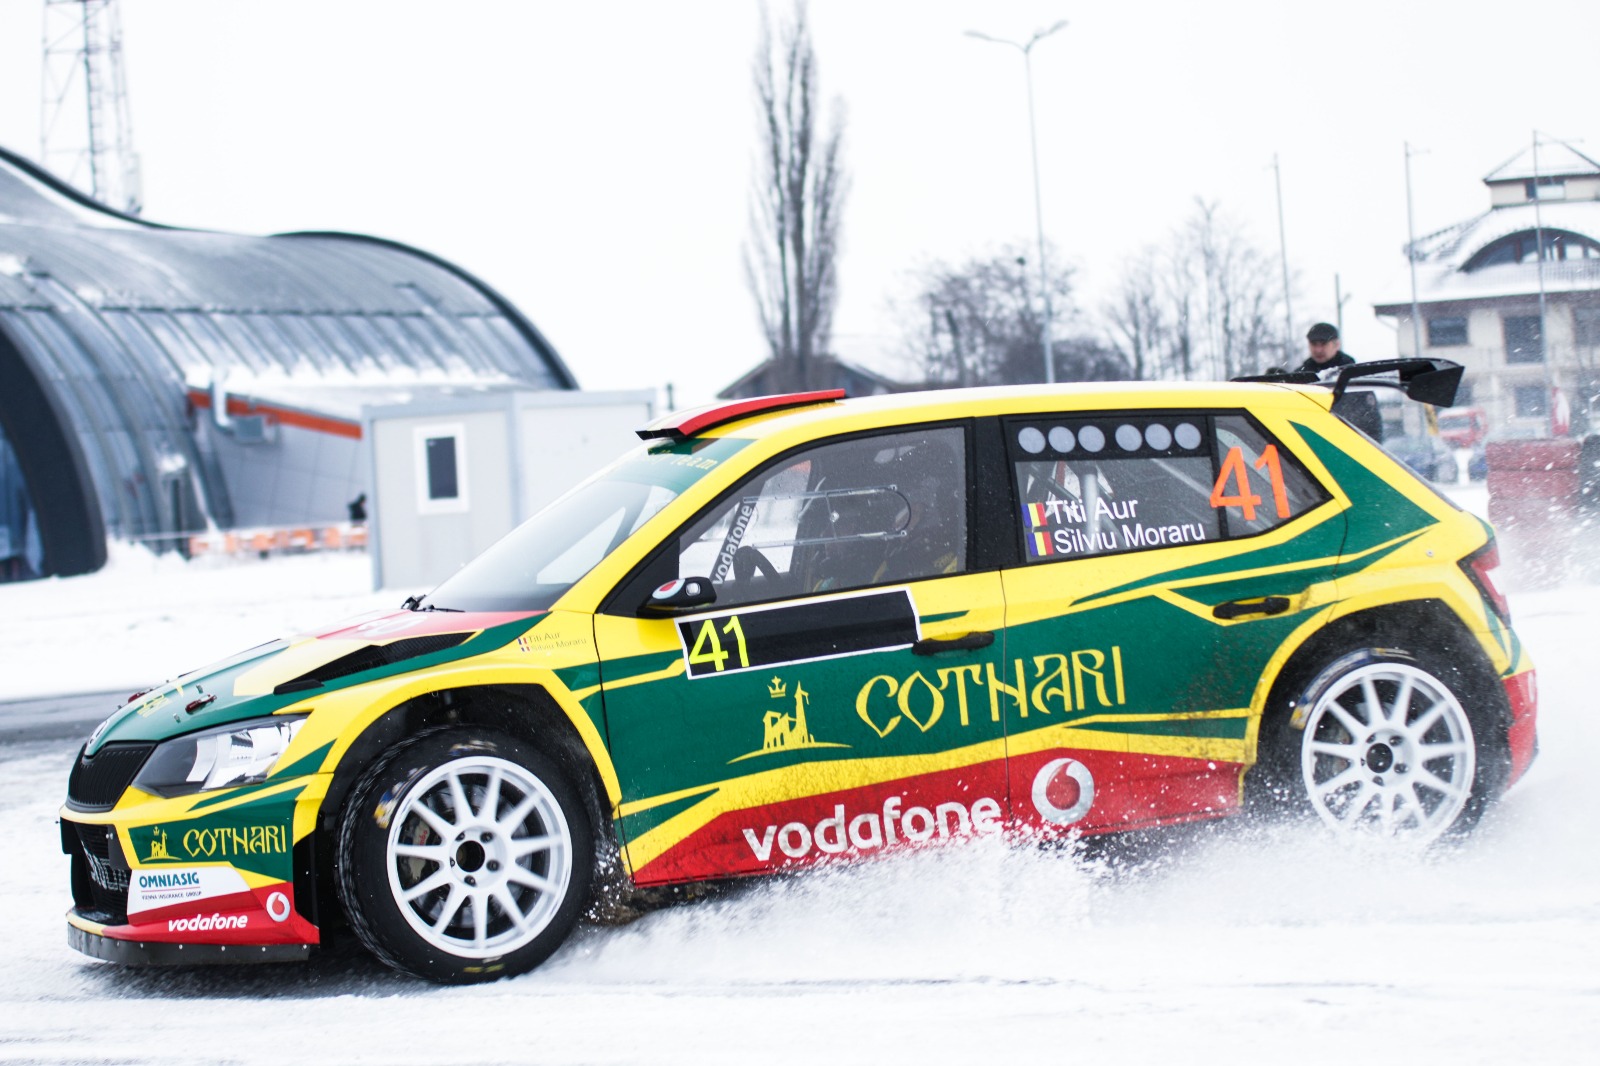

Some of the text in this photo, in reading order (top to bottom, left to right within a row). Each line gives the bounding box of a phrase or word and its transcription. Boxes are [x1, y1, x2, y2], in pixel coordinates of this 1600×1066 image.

[1210, 444, 1291, 521] 41
[1046, 496, 1139, 525] Titi Aur
[712, 504, 753, 585] vodafone
[1054, 522, 1206, 554] Silviu Moraru
[688, 615, 750, 672] 41
[855, 645, 1126, 738] COTNARI
[183, 825, 287, 857] COTNARI
[742, 796, 1002, 862] vodafone
[139, 872, 200, 888] OMNIASIG
[168, 912, 249, 932] vodafone
